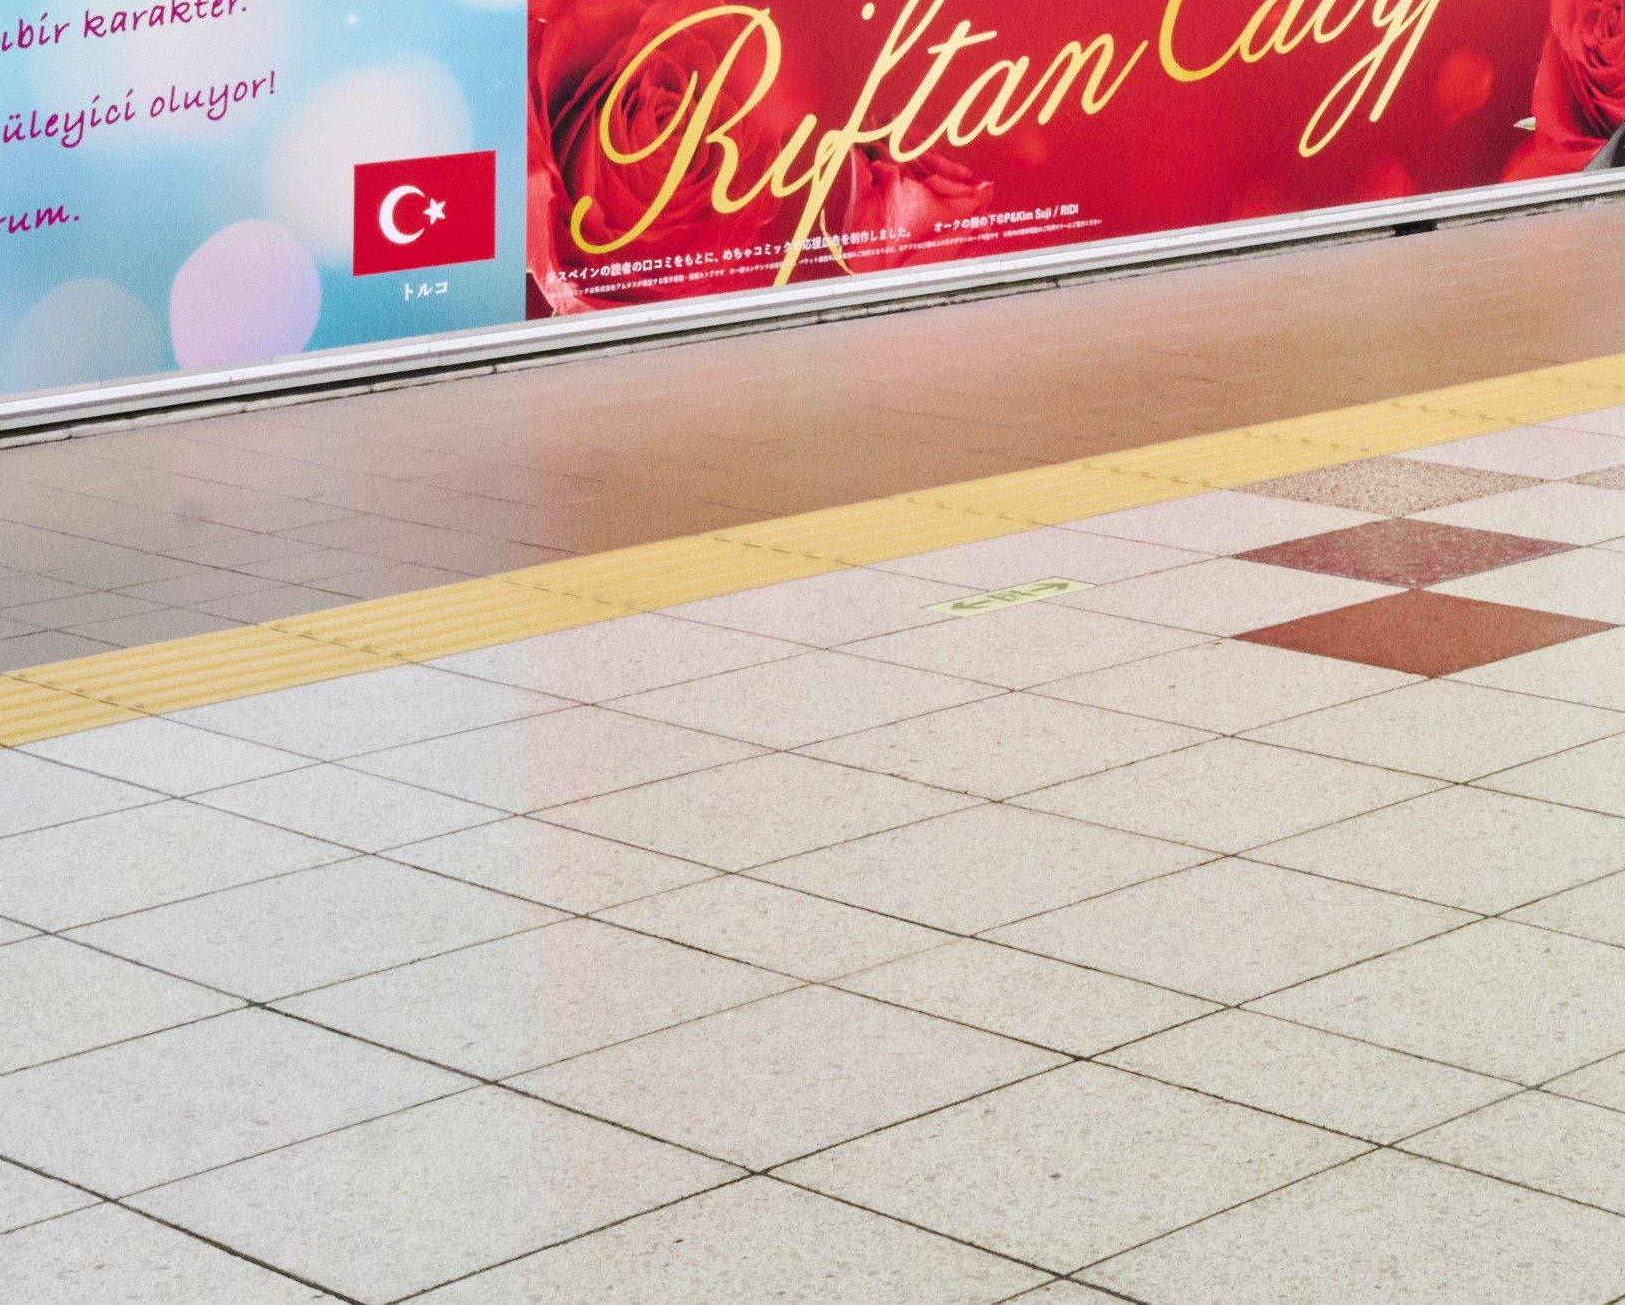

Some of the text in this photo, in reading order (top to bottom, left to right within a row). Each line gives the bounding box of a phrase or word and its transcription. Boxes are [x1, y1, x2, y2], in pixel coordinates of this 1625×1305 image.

[150, 72, 276, 121] oluyor!
[1060, 204, 1078, 216] RIDI
[403, 281, 449, 301] トルコ
